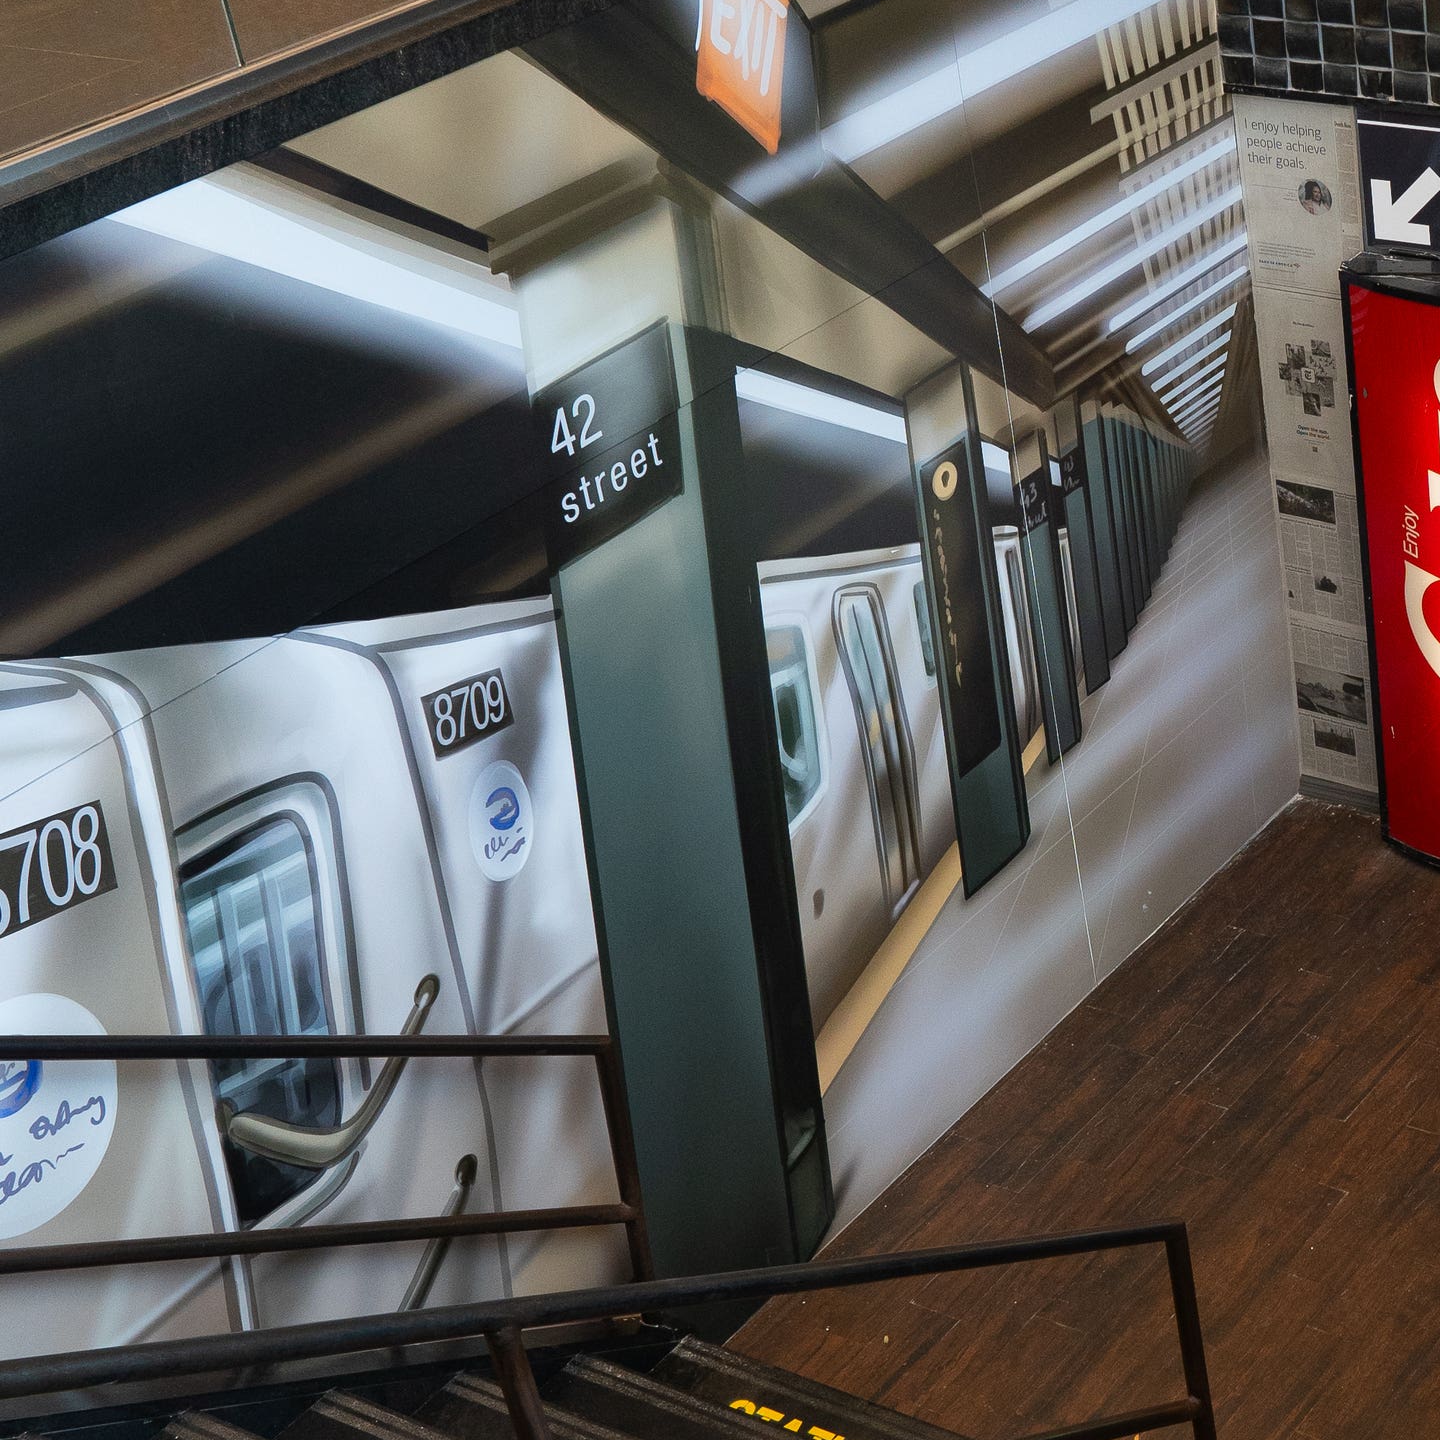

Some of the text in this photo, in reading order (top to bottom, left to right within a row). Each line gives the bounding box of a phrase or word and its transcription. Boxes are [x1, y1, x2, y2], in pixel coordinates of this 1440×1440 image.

[1246, 137, 1327, 156] people achieve
[1251, 120, 1279, 135] enjoy
[1282, 122, 1322, 142] helping
[1247, 152, 1308, 170] their goals.
[551, 393, 603, 456] 42
[561, 432, 663, 523] street
[1403, 505, 1420, 560] Enjoy
[433, 675, 505, 747] 8709
